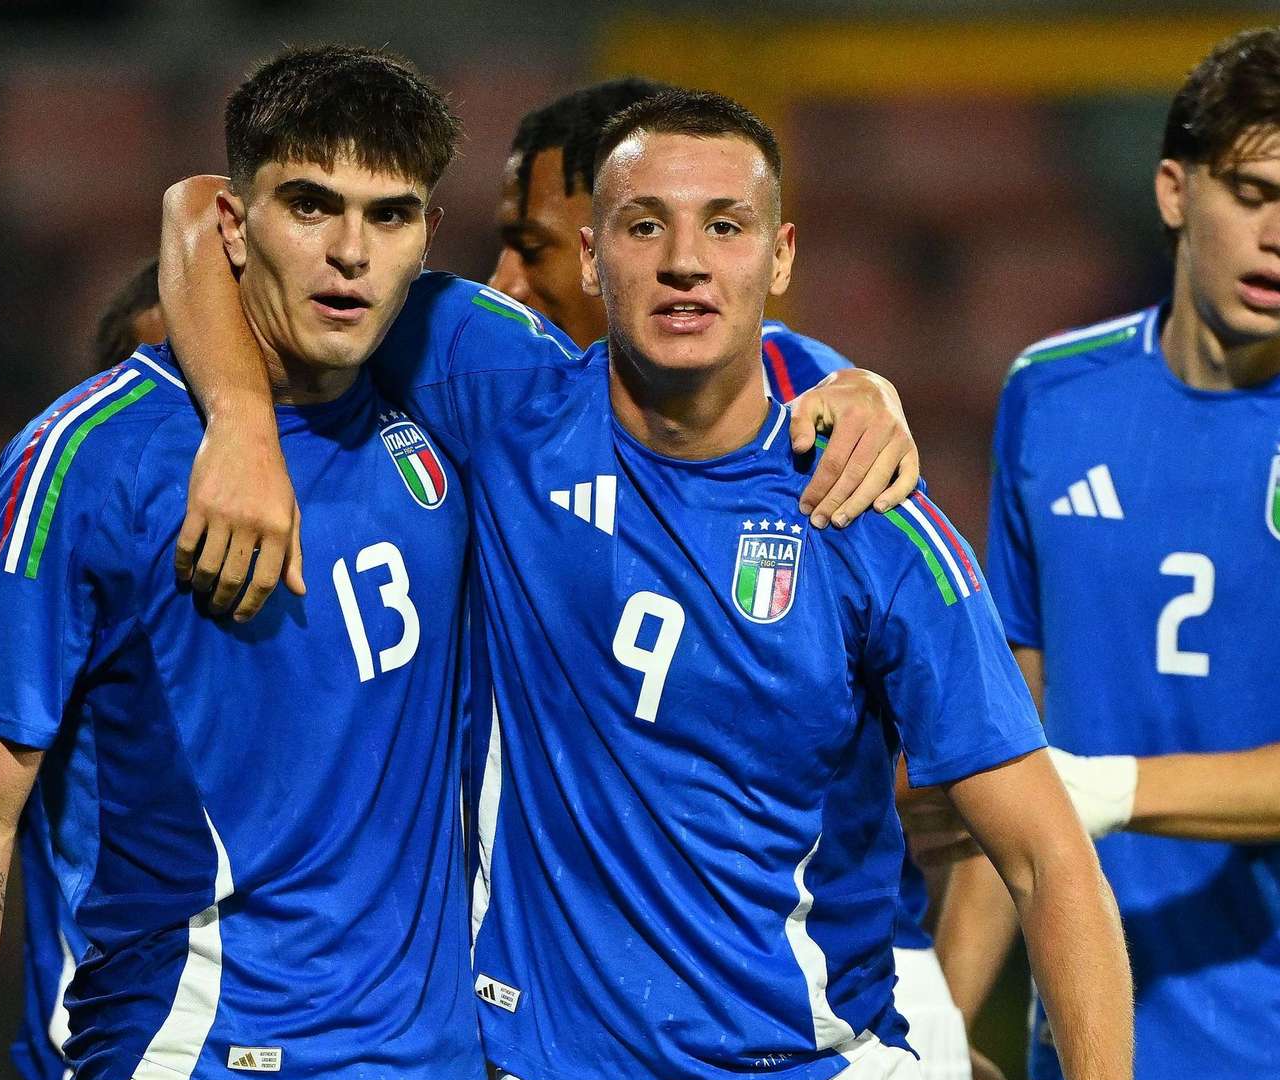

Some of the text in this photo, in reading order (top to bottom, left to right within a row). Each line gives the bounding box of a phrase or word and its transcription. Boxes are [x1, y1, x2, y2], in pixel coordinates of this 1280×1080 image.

[385, 427, 422, 451] ITALIA
[332, 541, 421, 682] 13
[743, 540, 794, 561] ITALIA
[612, 590, 686, 723] 9
[1156, 552, 1215, 677] 2
